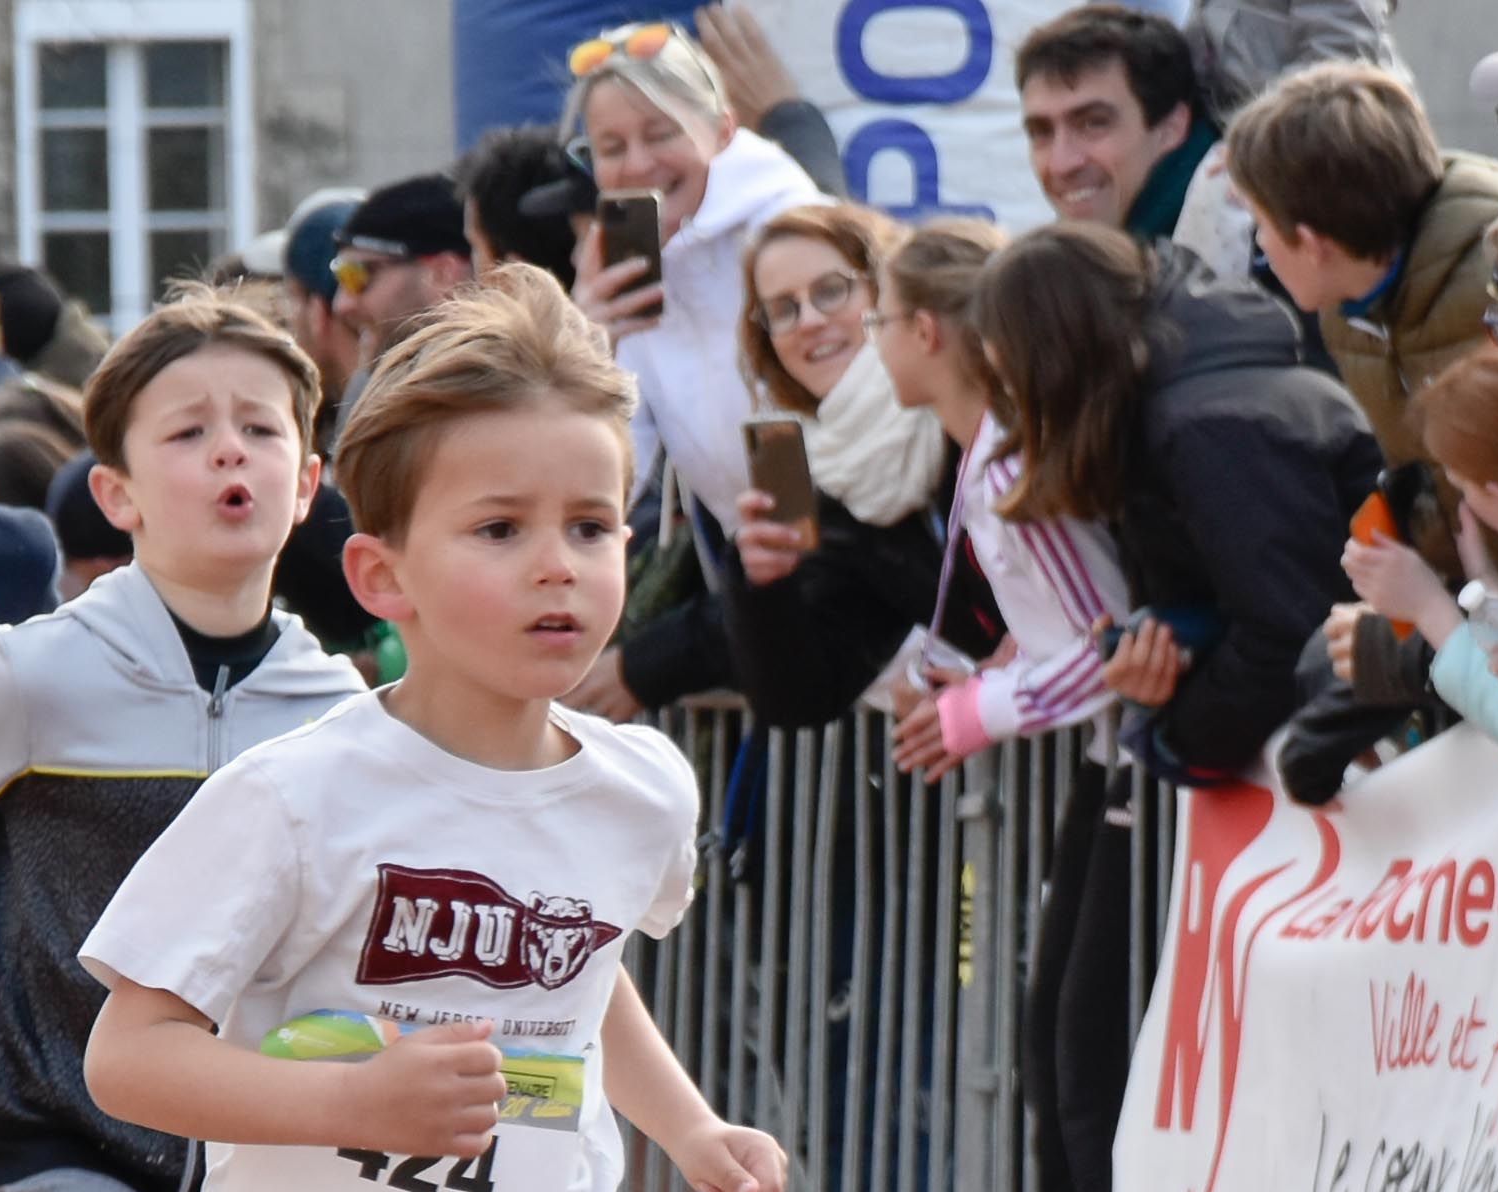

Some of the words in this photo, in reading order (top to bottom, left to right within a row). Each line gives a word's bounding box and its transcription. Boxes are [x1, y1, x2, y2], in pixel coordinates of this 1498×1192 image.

[381, 895, 517, 967] NJU
[377, 1000, 421, 1022] NEW
[426, 1009, 495, 1026] JERS
[1369, 970, 1440, 1077] Ville
[1448, 996, 1487, 1071] et
